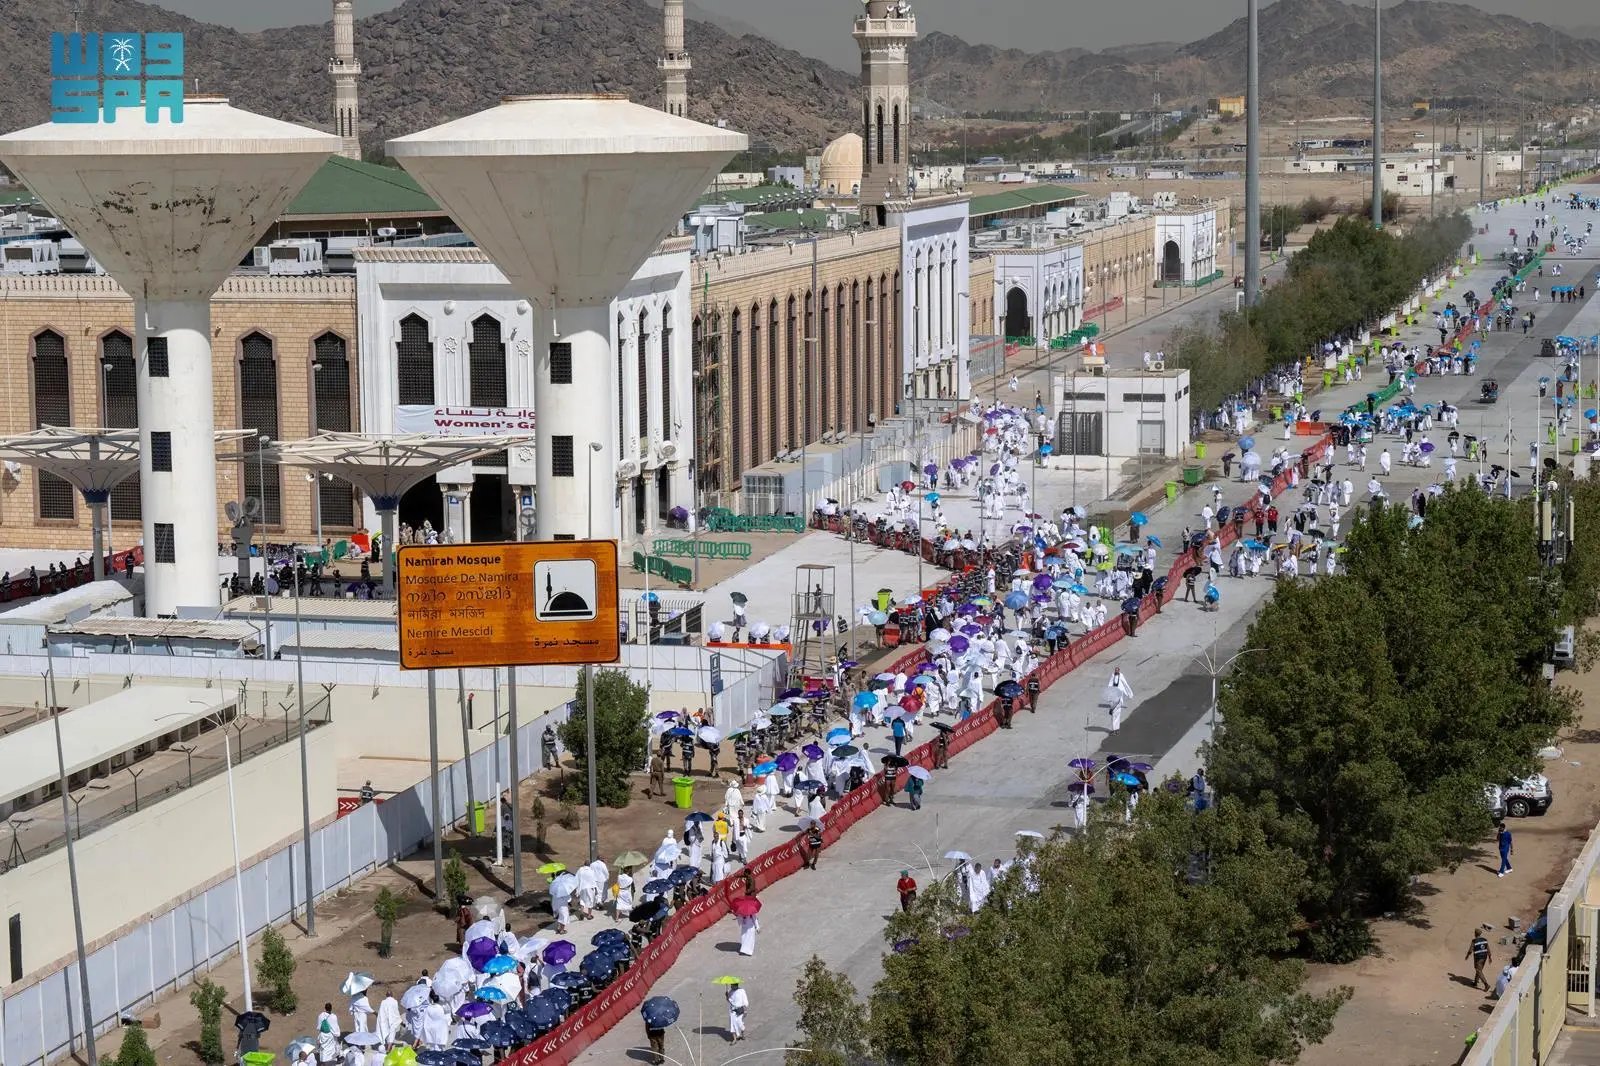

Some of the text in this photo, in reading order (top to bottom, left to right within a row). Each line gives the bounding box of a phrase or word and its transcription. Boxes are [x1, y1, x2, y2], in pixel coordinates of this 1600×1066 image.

[434, 419, 514, 429] Women's
[405, 555, 501, 567] Namirah Mosque
[405, 572, 519, 586] Mosquée De Namira
[407, 626, 493, 639] Nemire Mescidi
[534, 637, 600, 649] مسجد نمرة
[430, 647, 455, 656] مسجد
